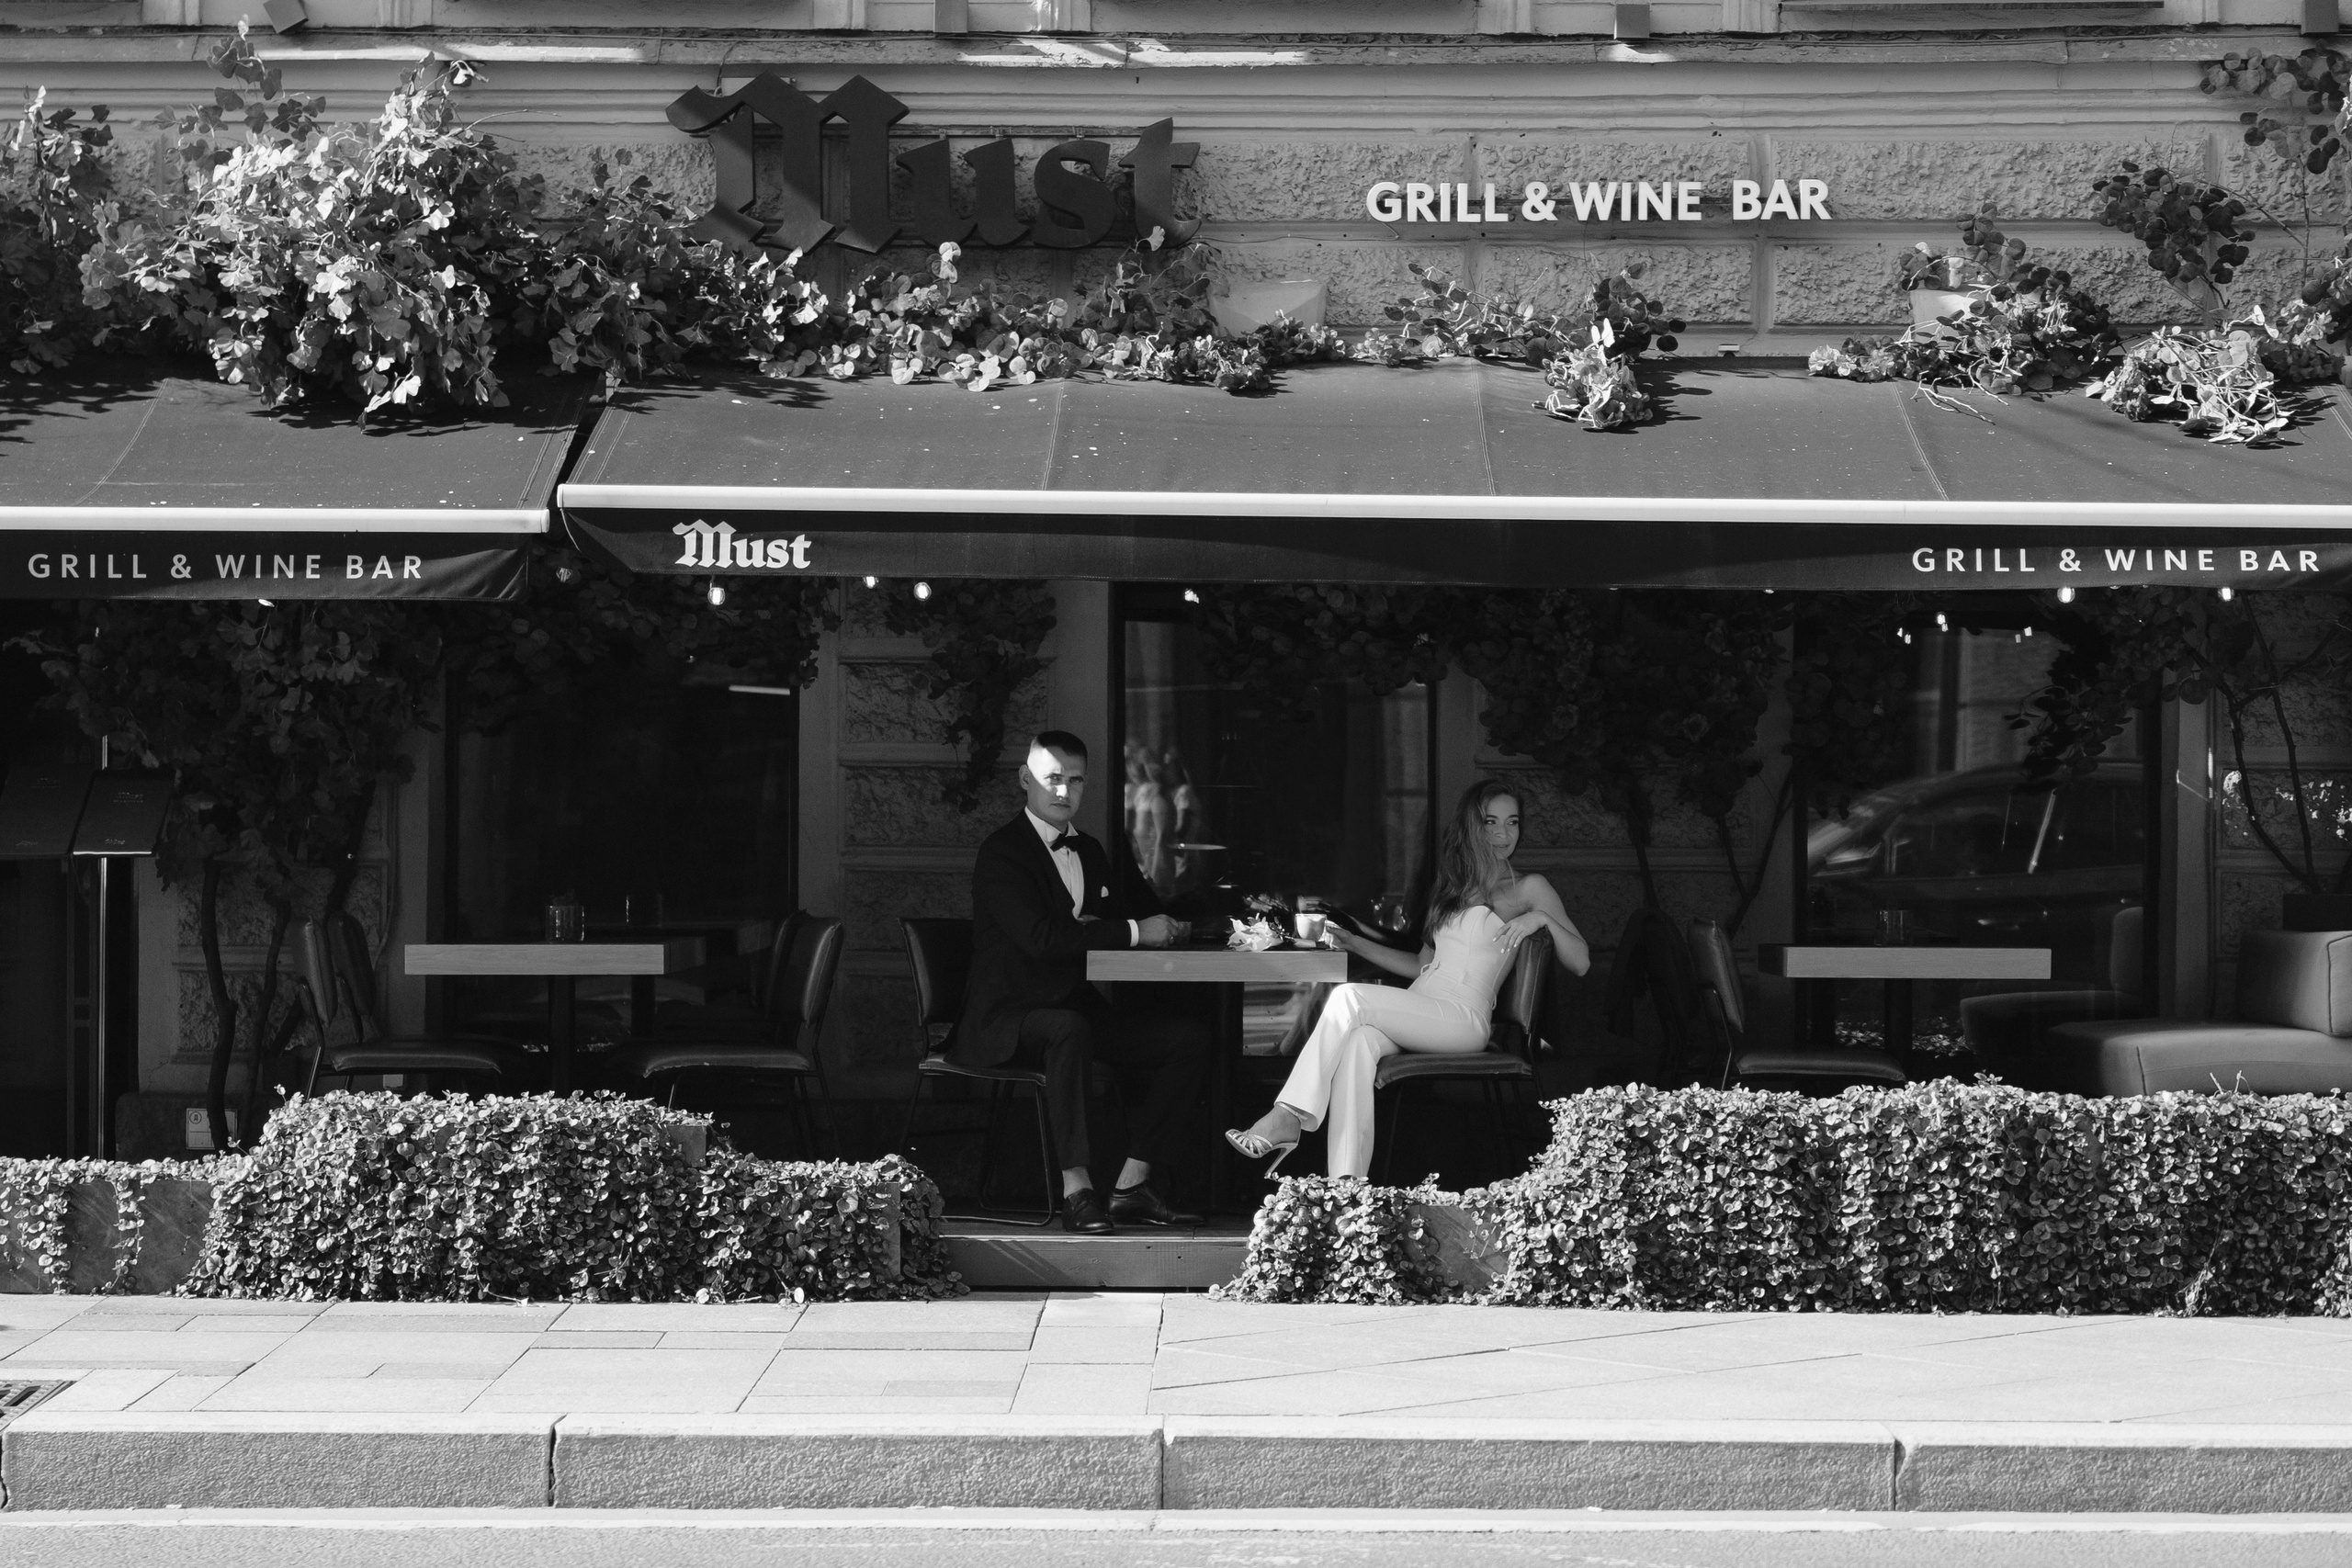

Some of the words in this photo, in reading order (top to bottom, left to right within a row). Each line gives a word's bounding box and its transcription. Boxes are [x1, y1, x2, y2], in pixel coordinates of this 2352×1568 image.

[665, 71, 1202, 254] Must
[1365, 181, 1510, 223] GRILL
[1521, 181, 1558, 221] &
[1568, 181, 1702, 221] WINE
[1733, 178, 1833, 220] BAR
[28, 553, 148, 579] GRILL
[170, 554, 193, 579] &
[215, 554, 322, 580] WINE
[345, 555, 423, 580] BAR
[672, 518, 812, 570] Must
[1912, 547, 2036, 572] GRILL
[2058, 548, 2083, 572] &
[2104, 548, 2215, 571] WINE
[2239, 549, 2321, 572] BAR
